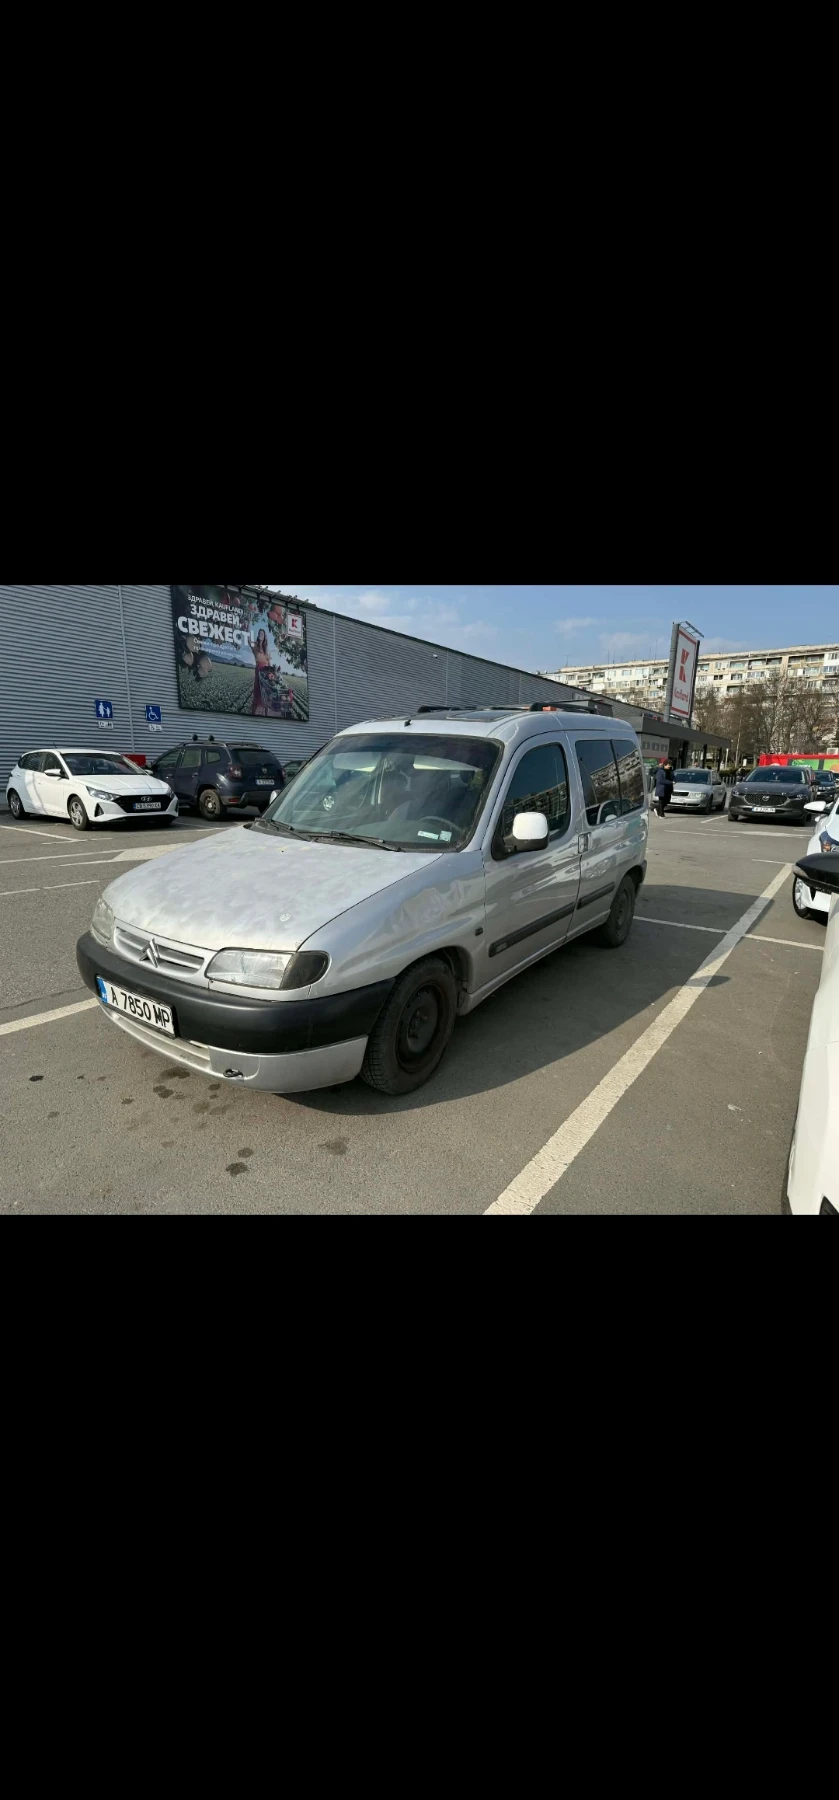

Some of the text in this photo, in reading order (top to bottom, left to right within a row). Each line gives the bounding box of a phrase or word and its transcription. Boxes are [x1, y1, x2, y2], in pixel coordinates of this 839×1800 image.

[187, 594, 214, 608] ЗДРАВЕЙ,
[190, 604, 242, 628] ЗДРАВЕЙ,
[177, 616, 255, 647] СВЕЖЕСТ!
[110, 986, 119, 1006] A
[120, 992, 151, 1021] 7850
[153, 1005, 170, 1028] MP
